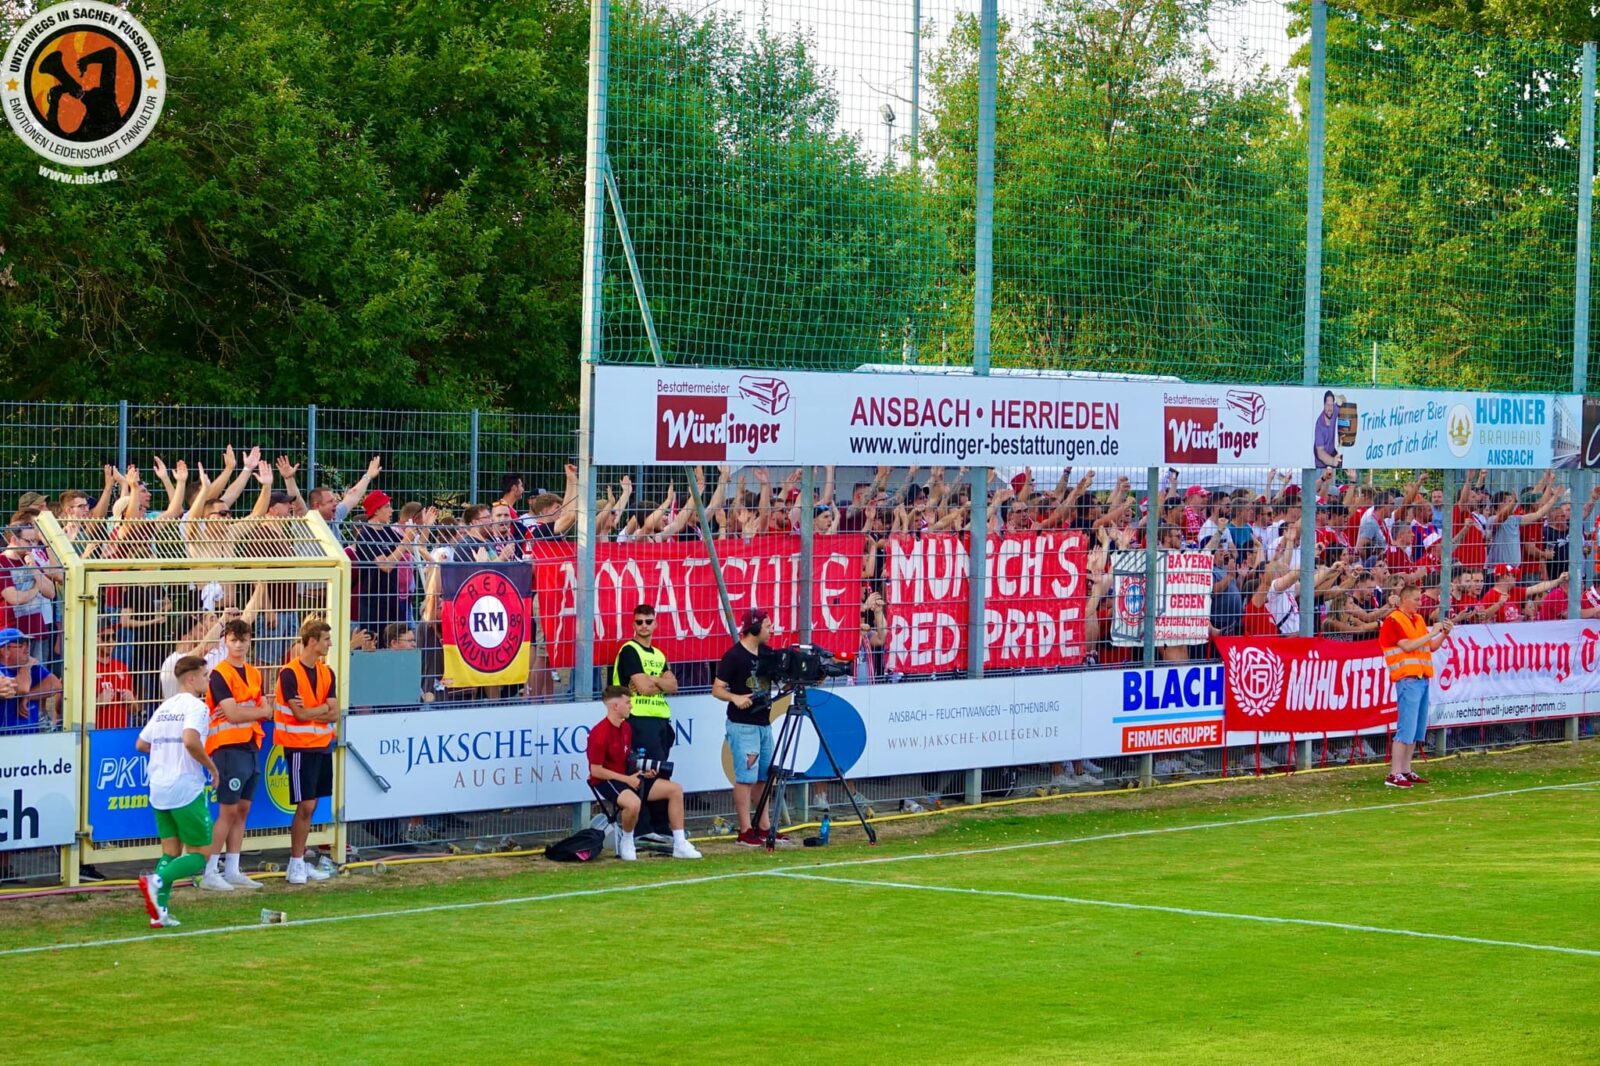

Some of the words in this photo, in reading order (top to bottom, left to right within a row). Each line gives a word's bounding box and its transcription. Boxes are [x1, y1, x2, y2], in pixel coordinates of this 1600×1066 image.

[657, 379, 730, 394] Bestattermeister
[1163, 392, 1219, 406] Bestattermeister
[850, 396, 970, 428] ANSBACH
[991, 400, 1119, 430] HERRIEDEN
[1361, 407, 1387, 432] Trink
[1390, 404, 1425, 427] Hürner
[1427, 400, 1448, 421] Bier
[1476, 397, 1545, 425] HÜRNER
[662, 409, 780, 454] Würdinger
[1169, 419, 1259, 458] Würdinger
[1480, 430, 1541, 446] BRAUHAUS
[850, 432, 1119, 461] www.würdinger-bestattungen.de
[1366, 438, 1384, 461] das
[1386, 436, 1402, 456] rat
[1405, 435, 1418, 454] ich
[1421, 430, 1439, 450] dir!
[1488, 448, 1534, 466] ANSBACH
[1168, 554, 1213, 570] BAYERN
[468, 576, 506, 599] RED
[1167, 573, 1211, 586] AMATEURE
[1170, 594, 1204, 609] GEGEN
[473, 612, 504, 632] RM
[887, 612, 960, 669] RED
[1122, 667, 1224, 711] BLACH
[888, 710, 927, 723] ANSBACH
[936, 705, 1000, 720] FEUCHTWANGEN
[1010, 700, 1060, 715] ROTHENBURG
[888, 726, 1059, 749] WWW.JAKSCHE-KOLLEGEN.DE
[1128, 725, 1217, 748] FIRMENGRUPPE
[0, 757, 72, 778] urach.de
[108, 794, 148, 810] zum
